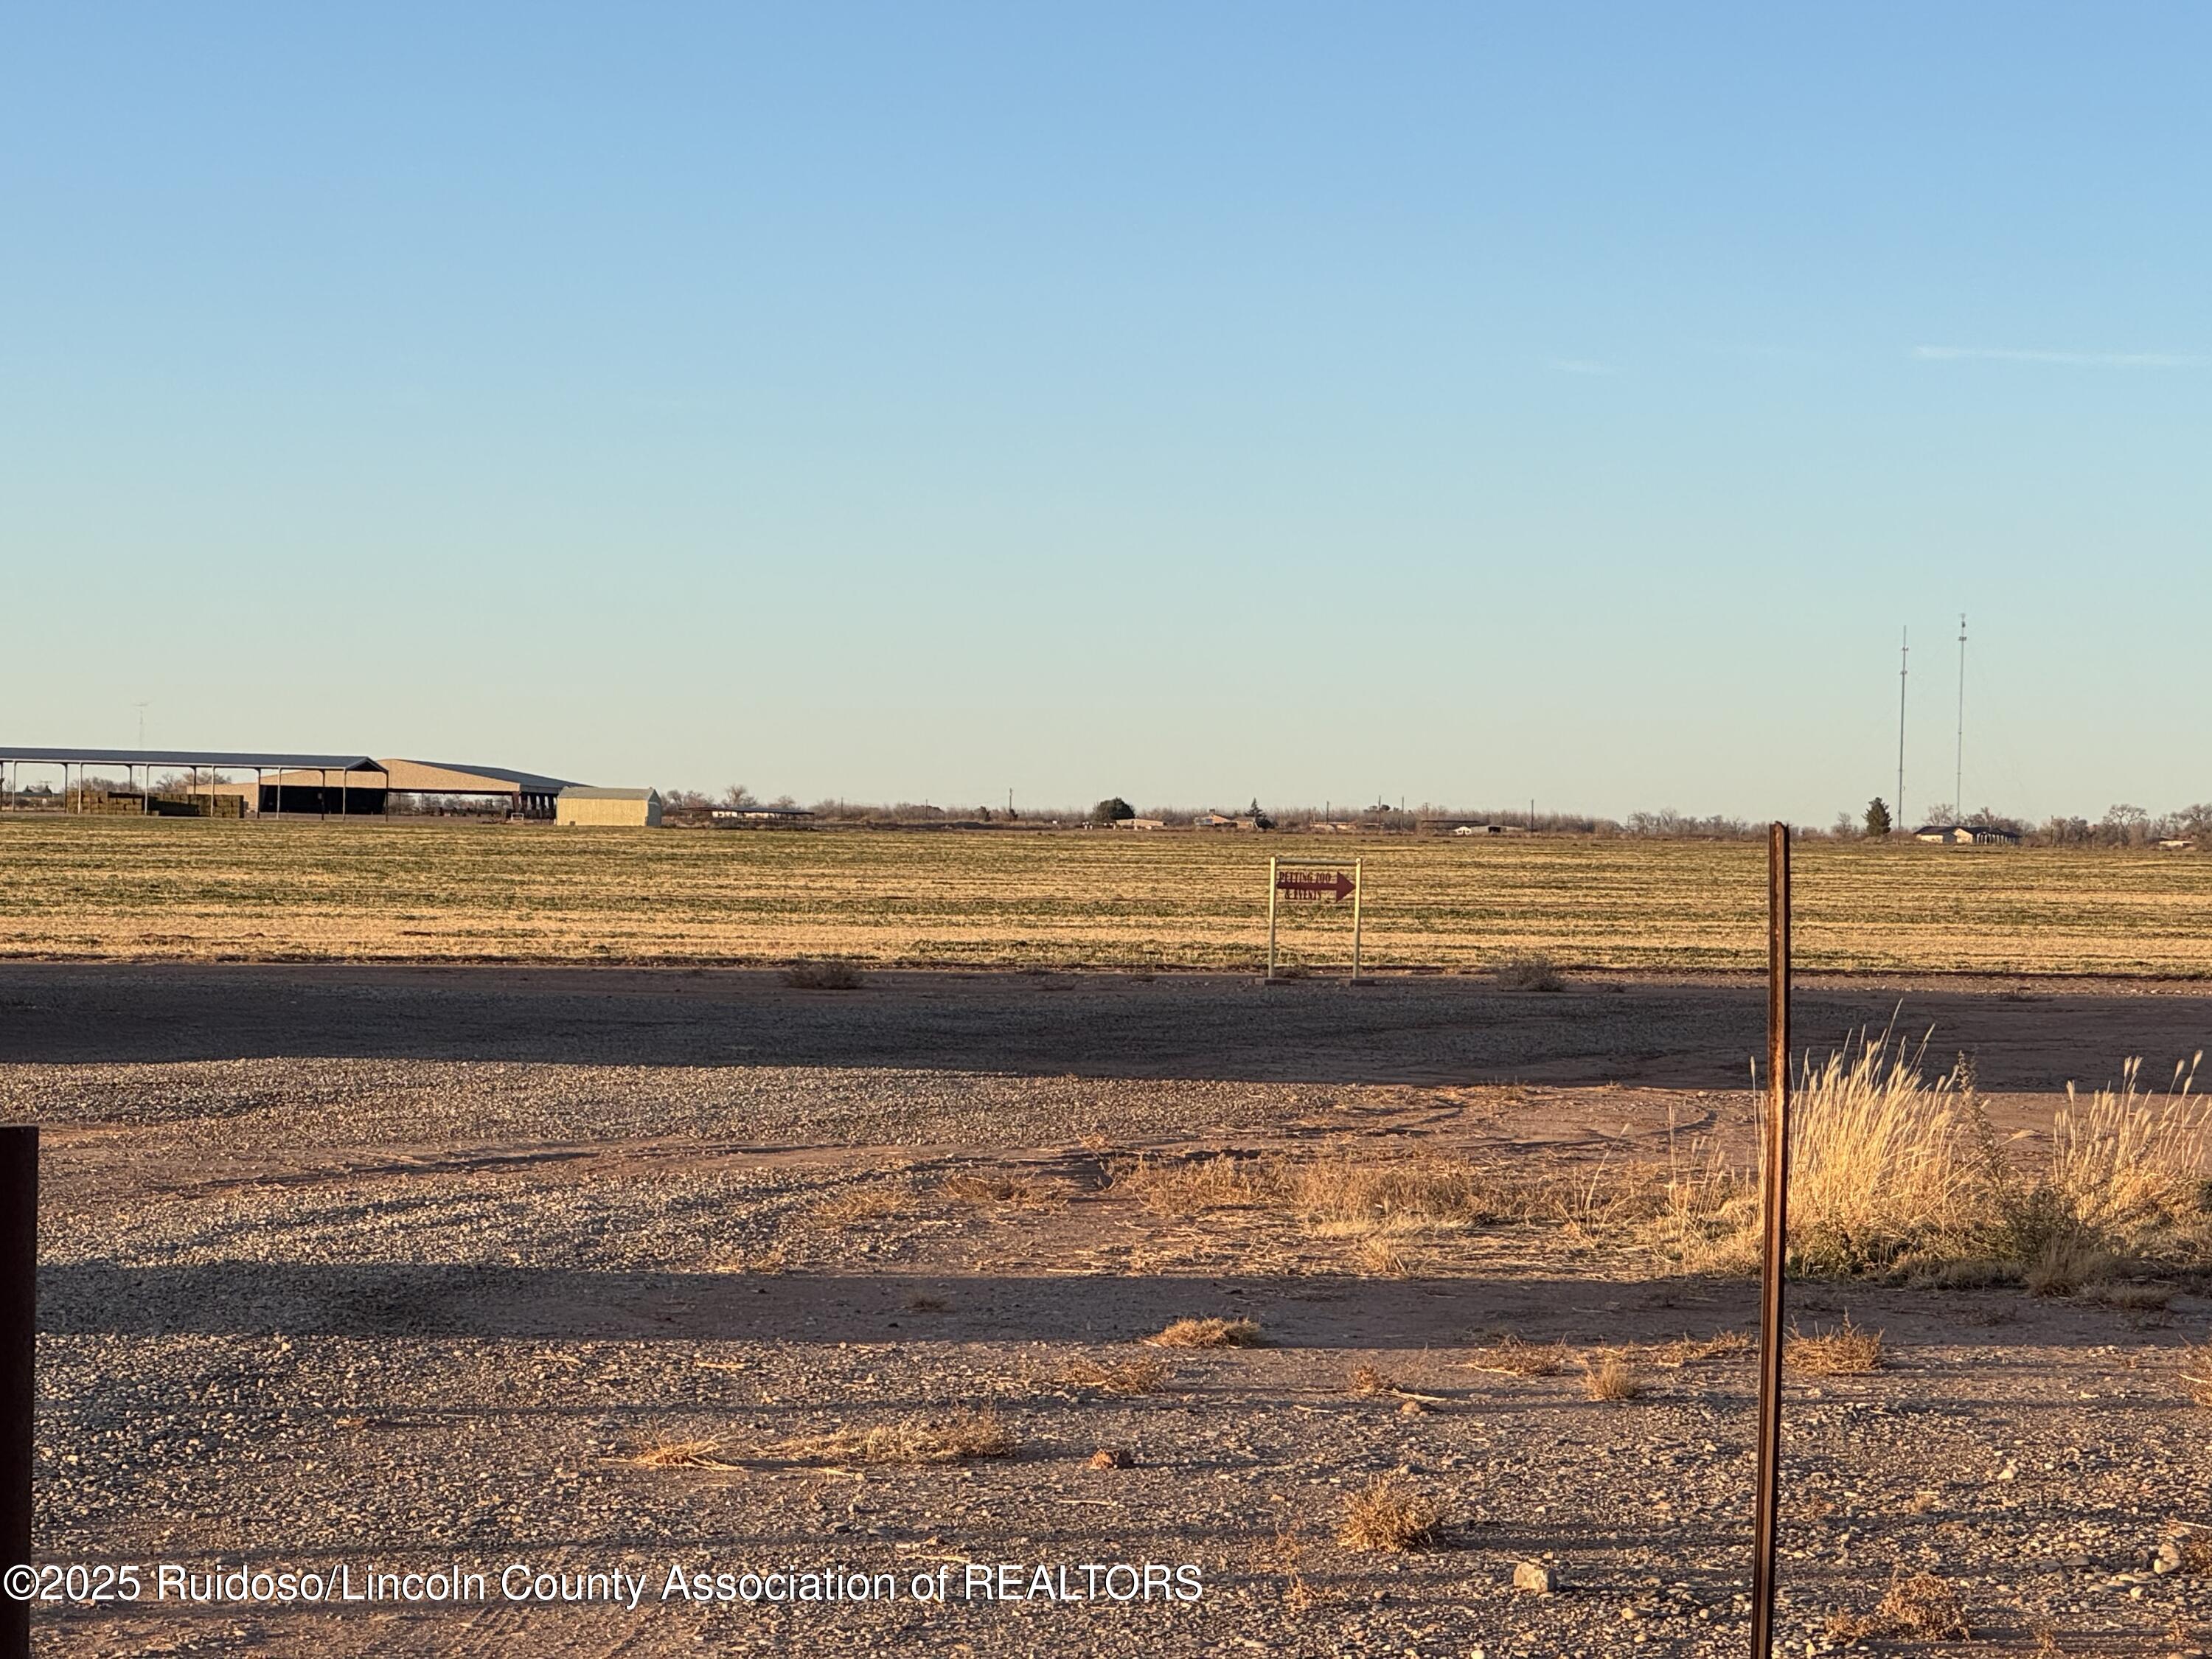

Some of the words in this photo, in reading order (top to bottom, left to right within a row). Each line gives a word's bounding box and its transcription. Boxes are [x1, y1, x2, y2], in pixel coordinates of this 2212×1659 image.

[1279, 872, 1313, 883] PETTING
[1315, 872, 1332, 883] ZOO
[1293, 889, 1322, 900] EVENTS
